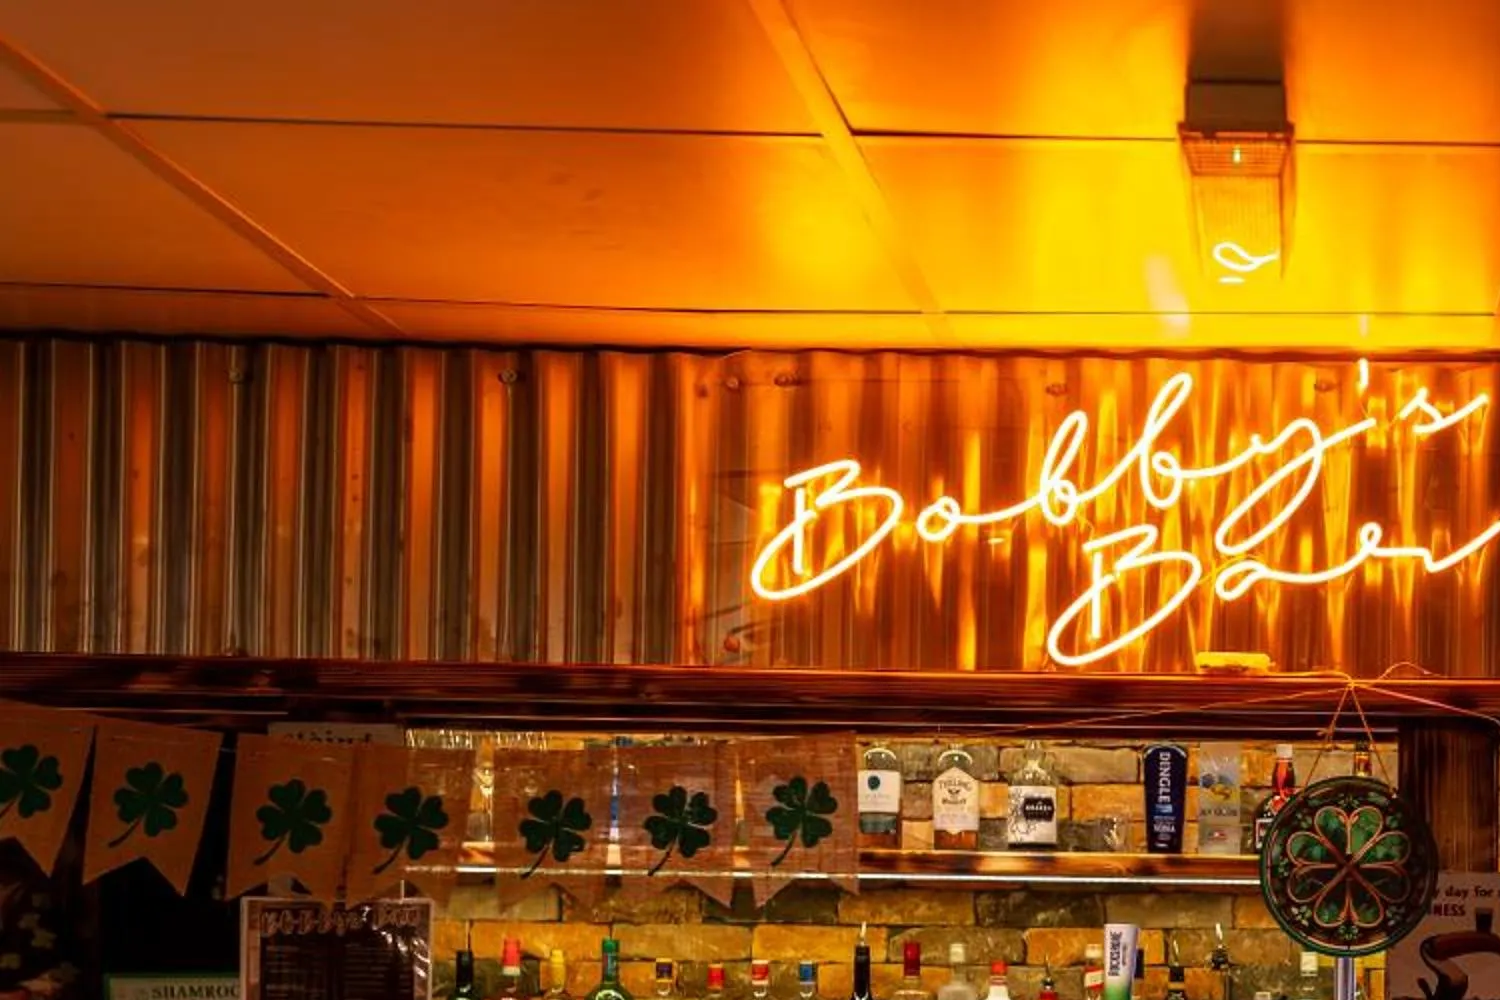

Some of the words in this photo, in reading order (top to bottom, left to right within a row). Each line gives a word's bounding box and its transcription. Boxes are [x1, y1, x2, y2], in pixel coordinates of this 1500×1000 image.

[751, 358, 1490, 600] Bobby's
[1158, 751, 1172, 804] DINGLE
[1444, 886, 1469, 899] day
[1473, 885, 1494, 898] for
[1433, 903, 1466, 917] NESS
[152, 985, 240, 998] SHAMROC
